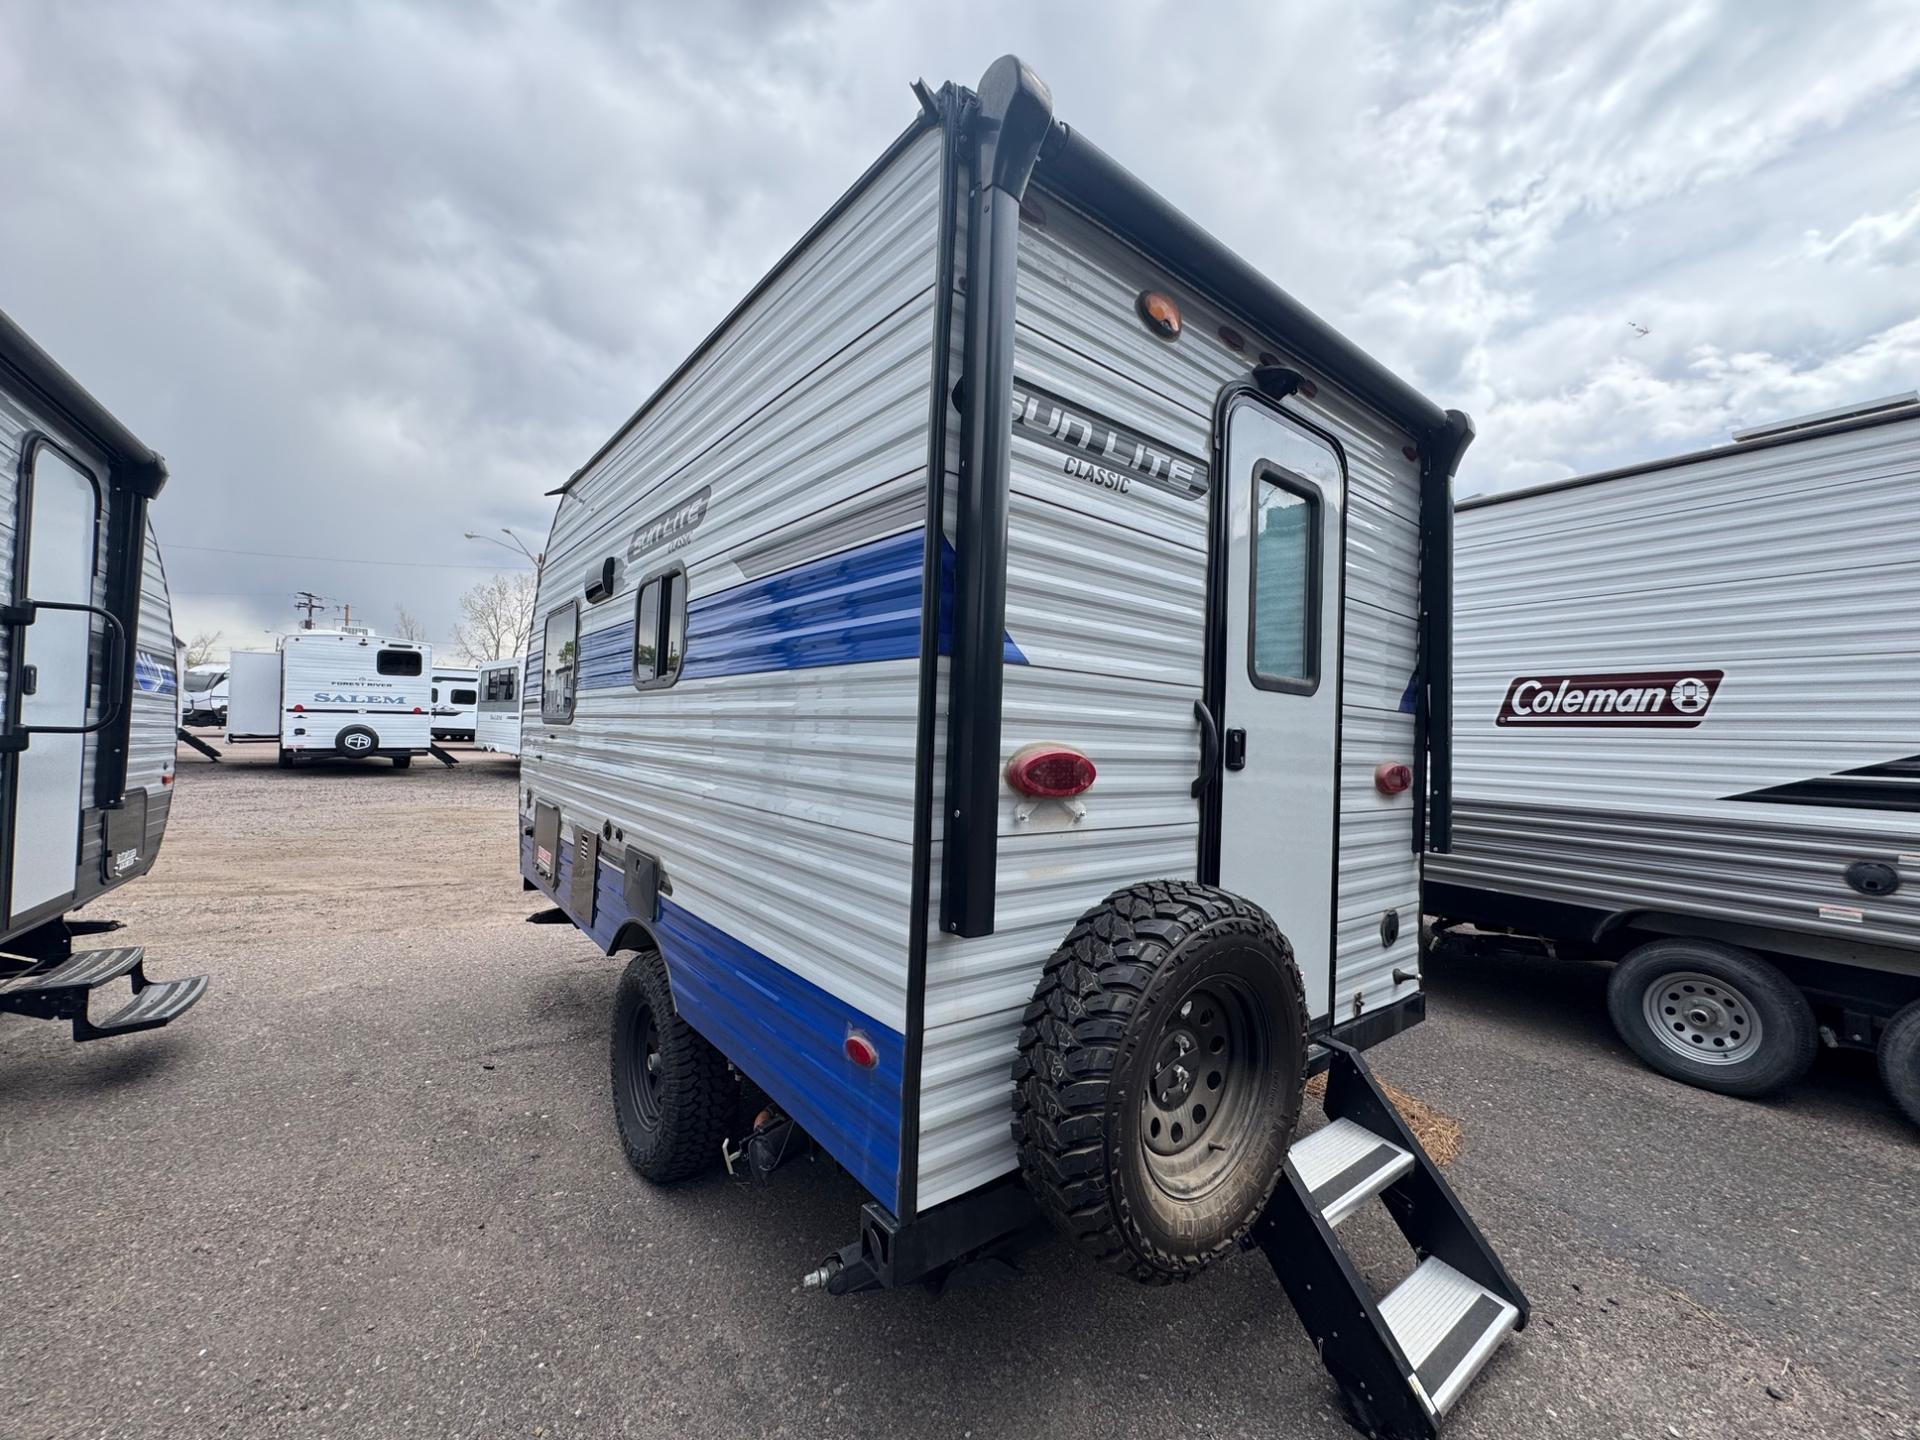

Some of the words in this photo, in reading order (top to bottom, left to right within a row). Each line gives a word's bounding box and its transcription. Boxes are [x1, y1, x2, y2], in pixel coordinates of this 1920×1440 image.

[1063, 455, 1132, 495] CLASSIC
[1102, 431, 1195, 491] LITE
[313, 692, 407, 705] SALEM
[1511, 679, 1667, 716] Coleman
